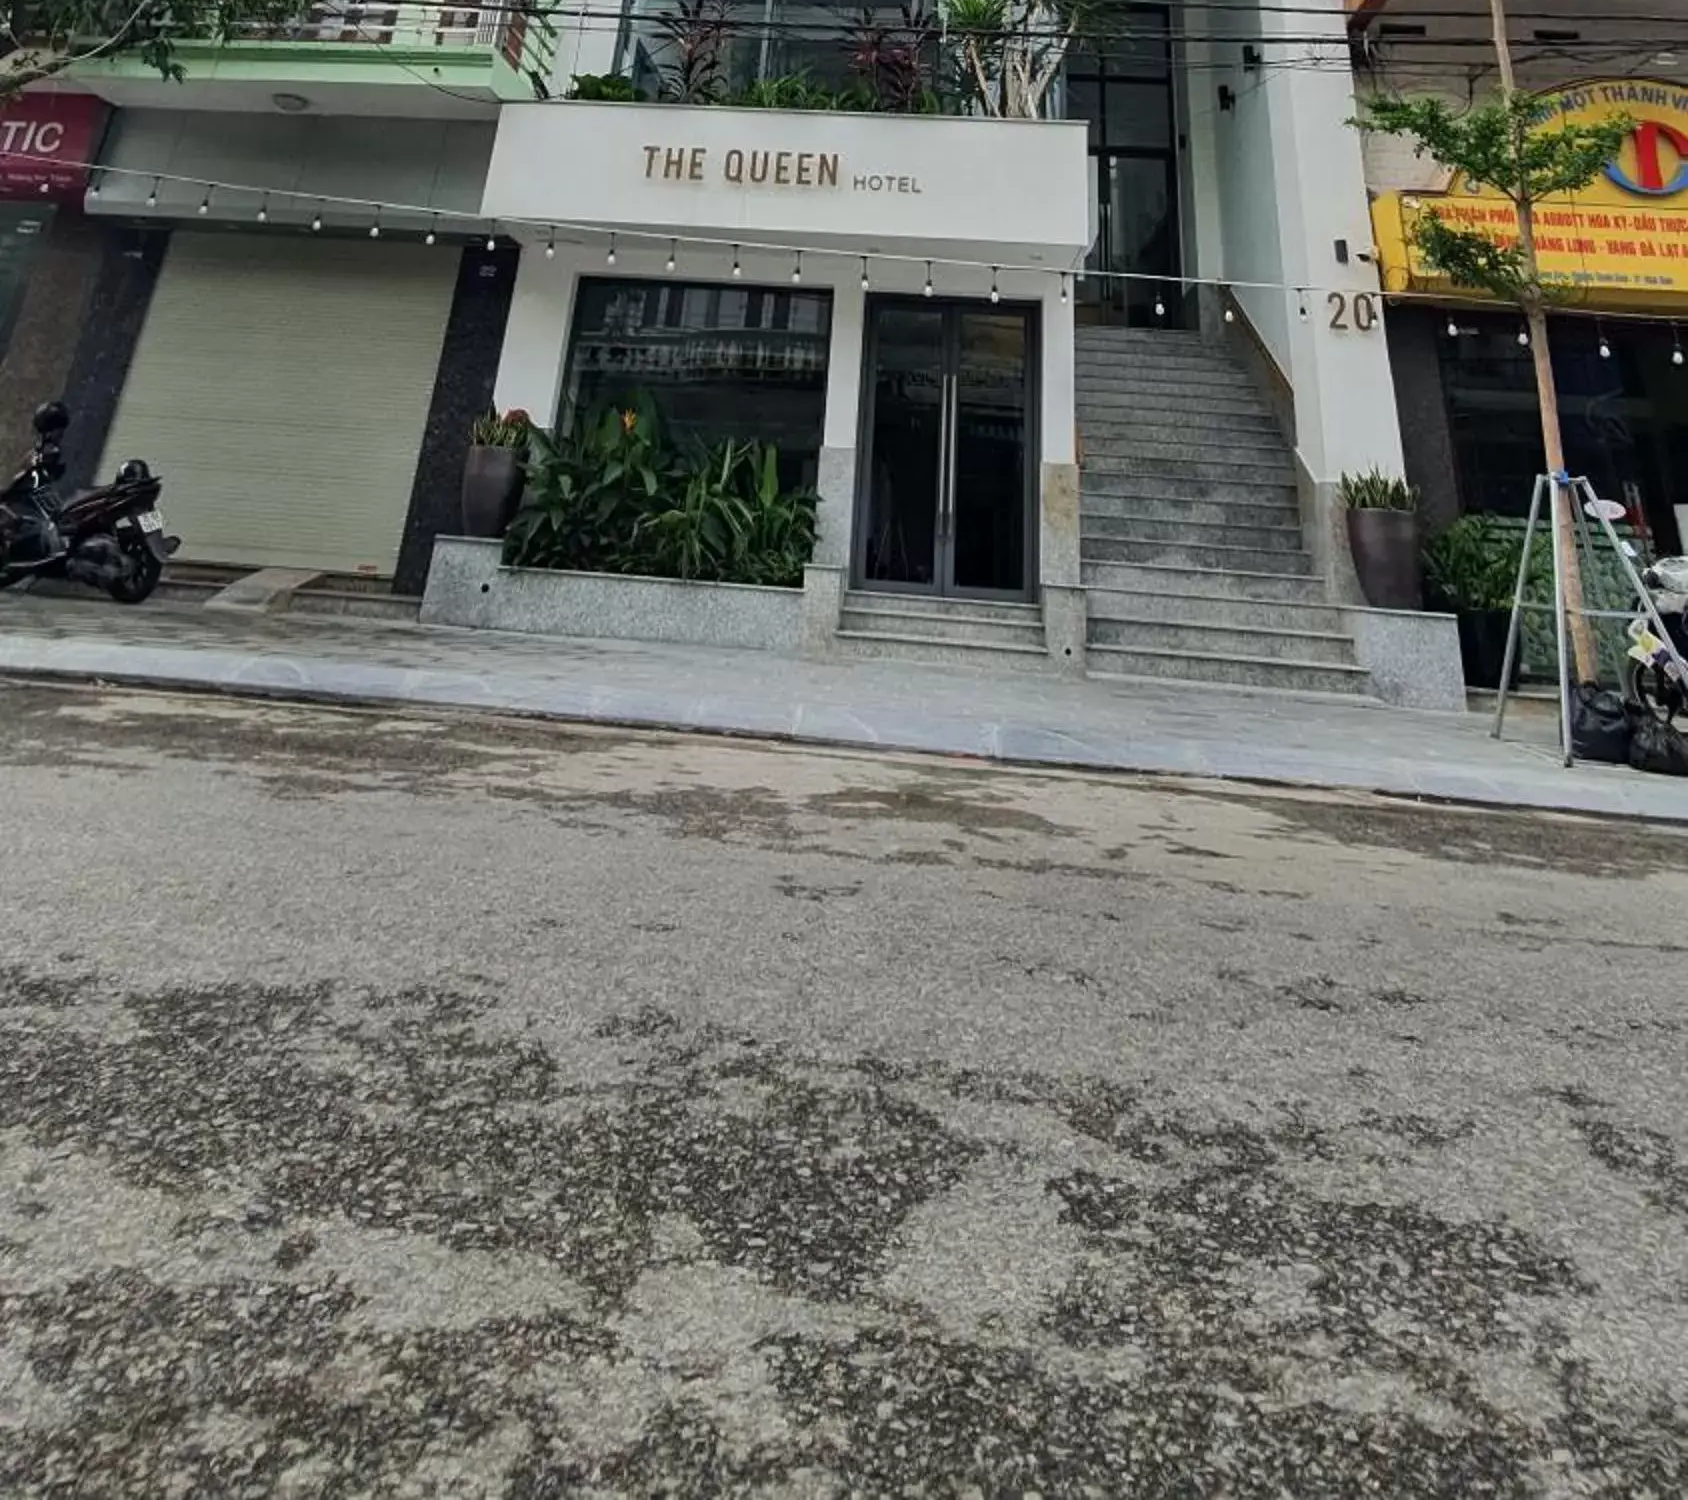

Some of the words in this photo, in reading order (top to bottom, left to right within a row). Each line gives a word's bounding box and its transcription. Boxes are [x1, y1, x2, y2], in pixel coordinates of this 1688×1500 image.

[1599, 82, 1668, 106] THÀNH
[2, 121, 64, 153] TIC
[643, 145, 706, 180] THE
[724, 149, 839, 186] QUEEN
[853, 174, 922, 193] HOTEL
[1587, 213, 1611, 229] HOA
[1328, 292, 1372, 331] 20
